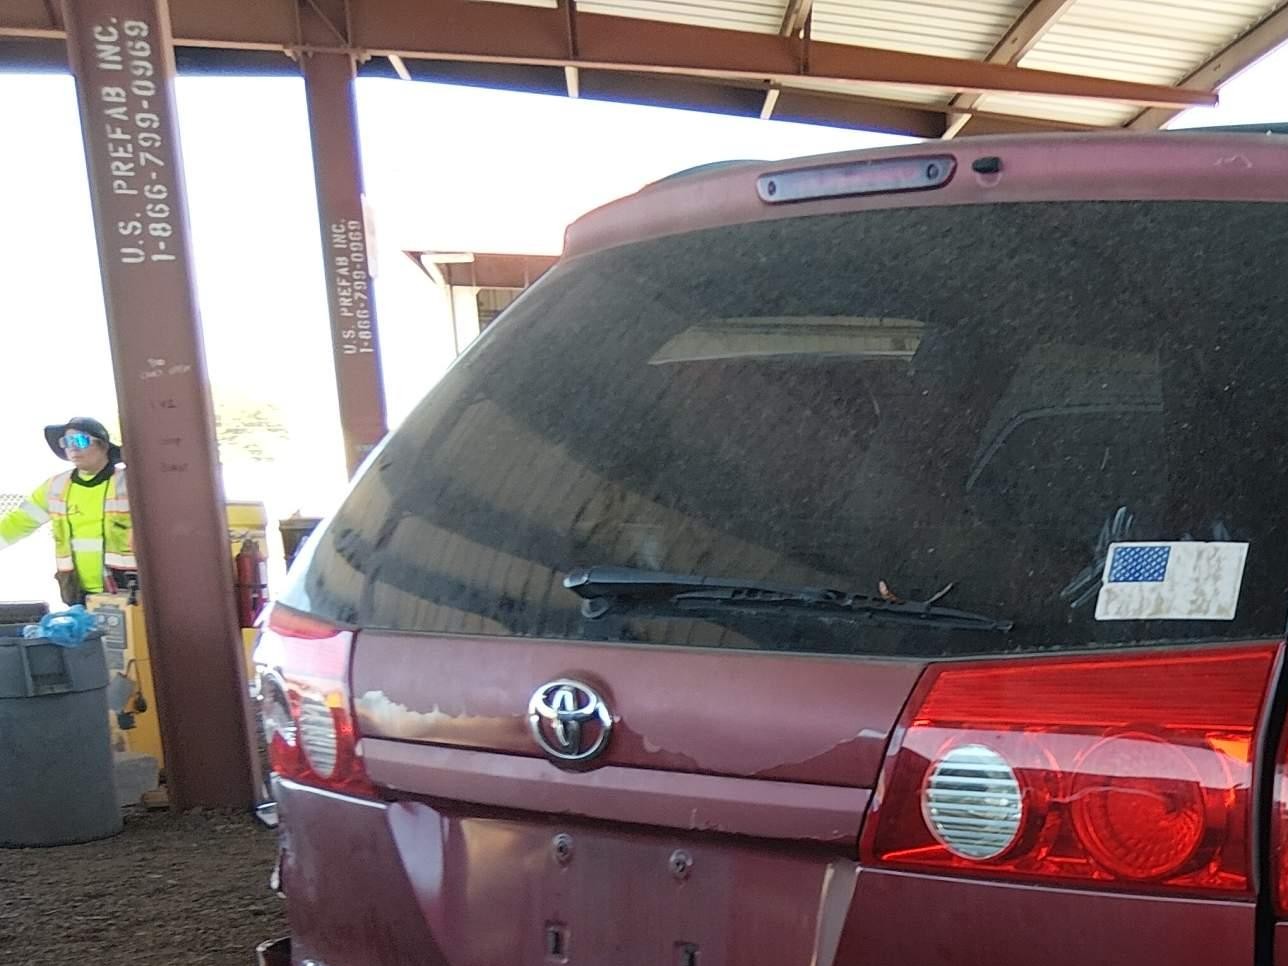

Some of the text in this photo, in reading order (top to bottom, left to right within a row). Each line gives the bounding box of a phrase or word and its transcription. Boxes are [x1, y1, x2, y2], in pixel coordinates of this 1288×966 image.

[93, 17, 145, 263] U.S. PREFAB INC.
[124, 20, 176, 261] 1-866-799-0969
[331, 218, 357, 354] U.S. PREFAB INC.
